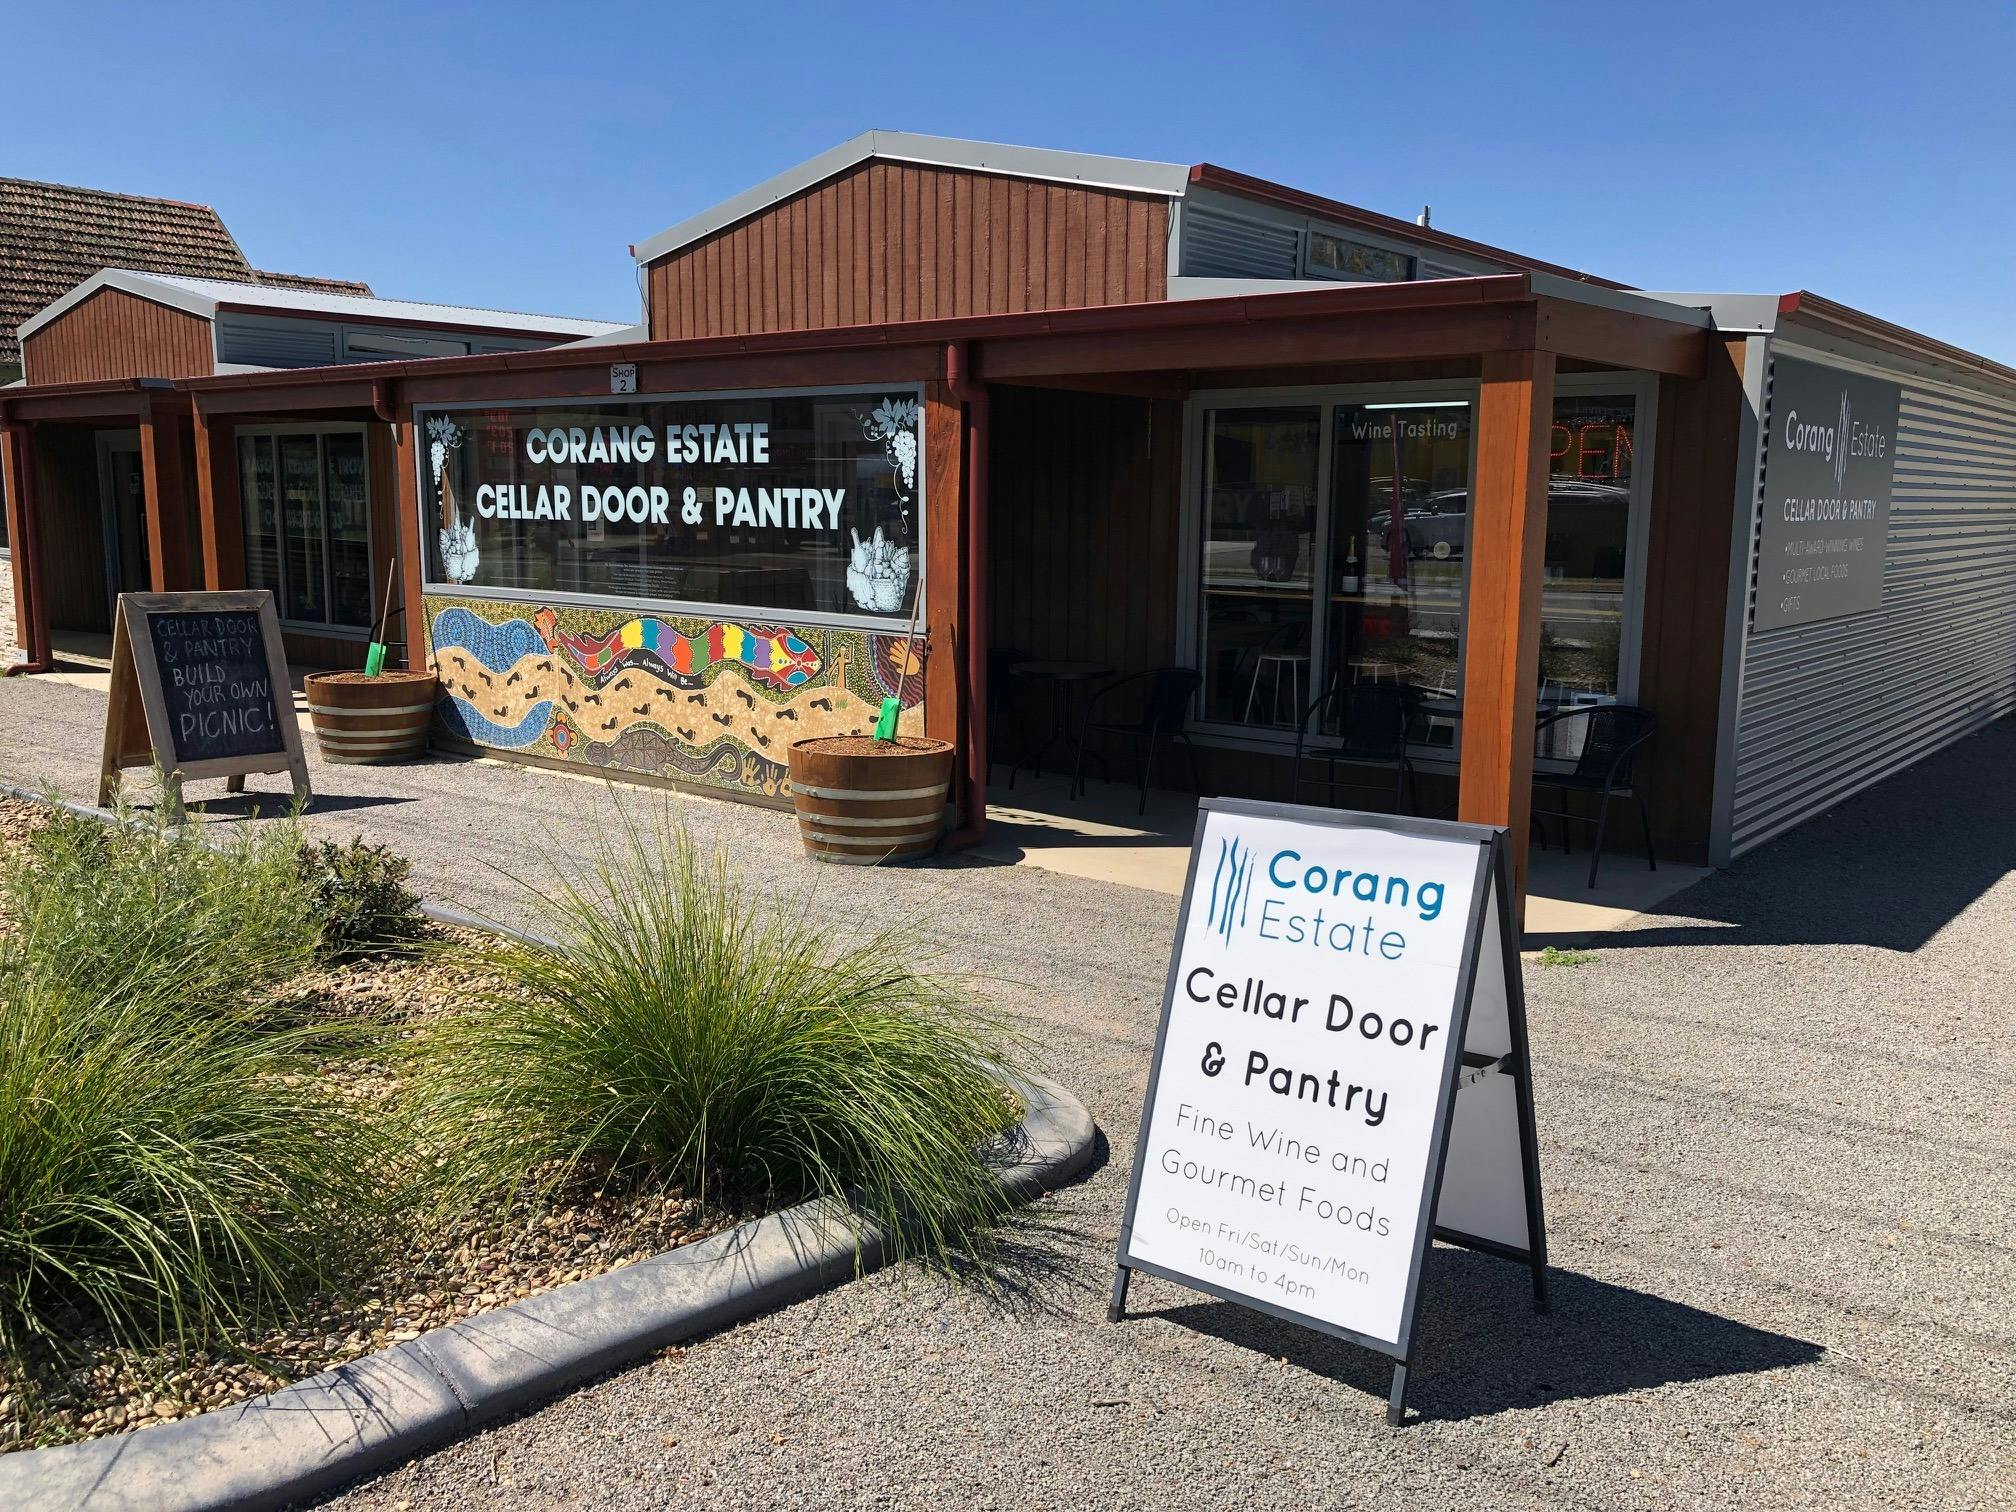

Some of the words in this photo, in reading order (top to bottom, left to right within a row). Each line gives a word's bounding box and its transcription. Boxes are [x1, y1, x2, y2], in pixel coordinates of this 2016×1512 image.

[612, 367, 635, 378] SHOP
[620, 379, 627, 392] 2
[526, 425, 655, 464] CORANG
[666, 423, 770, 464] ESTATE
[1352, 421, 1392, 439] Wine
[1397, 419, 1457, 440] Tasting
[1785, 410, 1834, 462] Corang
[1851, 421, 1886, 458] Estate
[1550, 424, 1634, 480] PEN
[475, 484, 572, 522] CELLAR
[581, 485, 669, 525] DOOR
[682, 488, 704, 527] &
[715, 488, 846, 531] PANTRY
[1783, 497, 1815, 522] CELLAR
[1816, 498, 1841, 521] DOOR
[1842, 499, 1848, 520] &
[1849, 498, 1877, 520] PANTRY
[157, 619, 213, 638] CELLAR
[214, 617, 259, 637] DOOR
[163, 641, 177, 662] &
[185, 637, 254, 657] PANTRY
[172, 663, 226, 687] BUILD
[600, 666, 618, 684] Always
[642, 657, 664, 673] Always
[184, 685, 226, 711] YOUR
[230, 678, 268, 700] OWN
[180, 701, 275, 742] PICNIC!
[1268, 849, 1446, 922] Corang
[1258, 899, 1406, 961] Estate
[1185, 966, 1310, 1023] Cellar
[1325, 993, 1439, 1051] Door
[1200, 1041, 1226, 1078] &
[1244, 1050, 1389, 1128] Pantry
[1176, 1103, 1234, 1140] Fine
[1247, 1121, 1321, 1164] Wine
[1331, 1152, 1390, 1184] and
[1161, 1149, 1286, 1206] Gourmet
[1298, 1186, 1391, 1237] Foods
[1166, 1207, 1211, 1235] Open
[1217, 1222, 1370, 1285] Fri/Sat/Sun/Mon
[1199, 1247, 1244, 1277] 10am
[1250, 1263, 1268, 1284] to
[1275, 1273, 1316, 1300] 4pm
